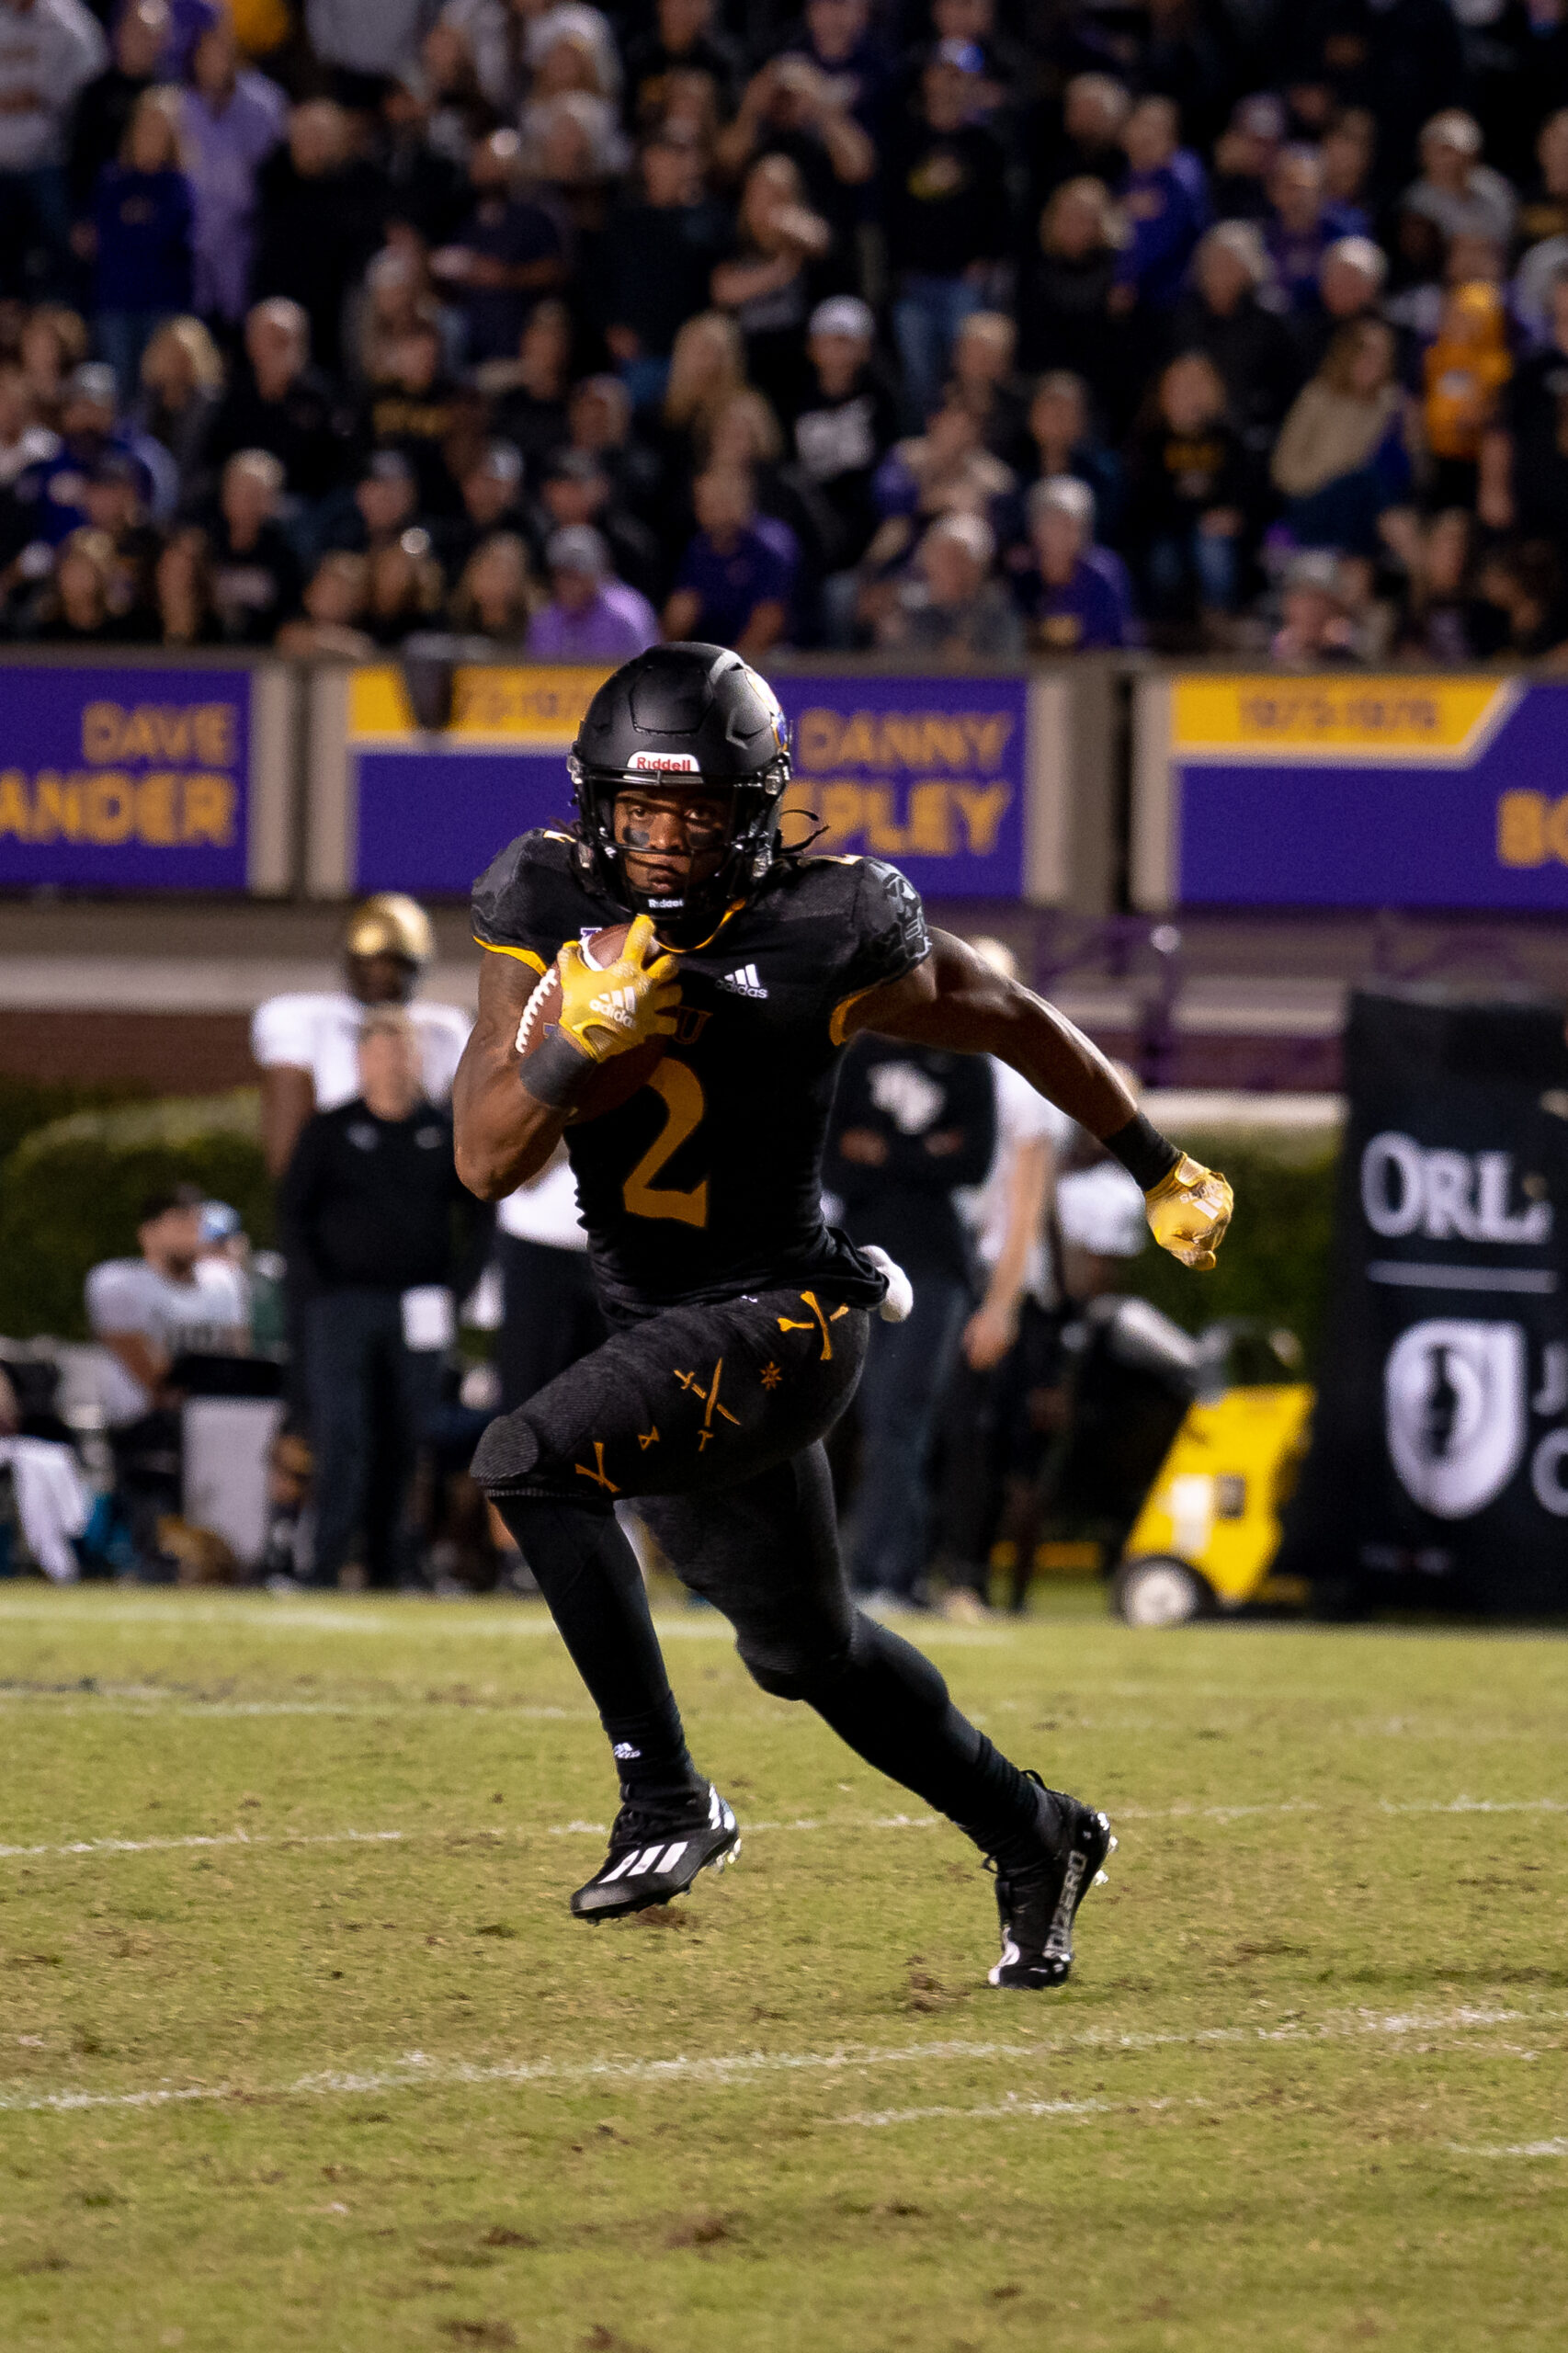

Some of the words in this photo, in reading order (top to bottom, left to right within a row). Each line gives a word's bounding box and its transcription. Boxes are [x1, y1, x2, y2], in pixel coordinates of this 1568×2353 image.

[82, 701, 235, 766] DAVE
[798, 708, 1012, 773] DANNY
[637, 756, 691, 771] Riddell
[716, 979, 769, 999] adidas
[589, 998, 637, 1029] adida
[623, 1056, 710, 1229] 2
